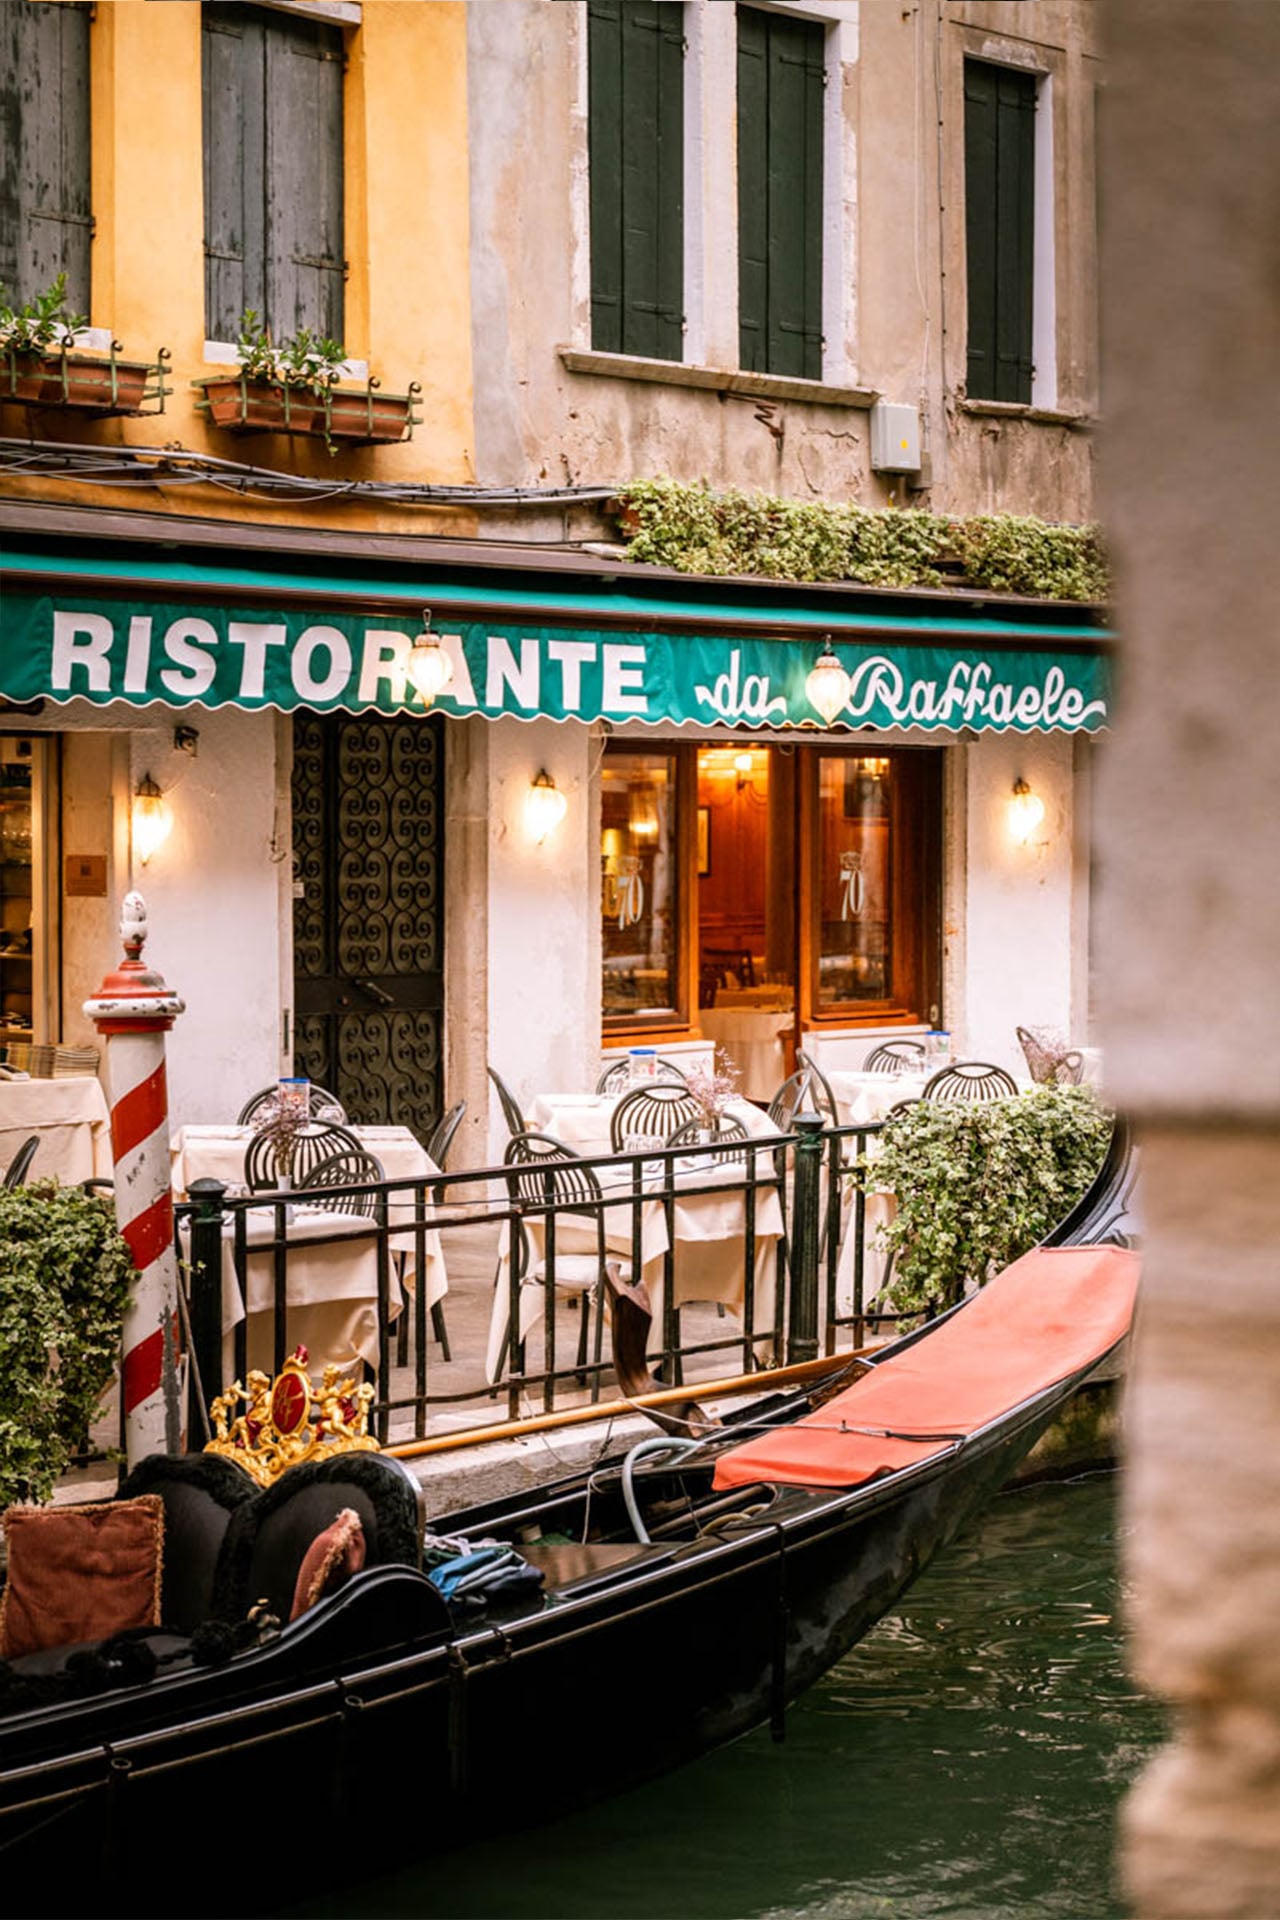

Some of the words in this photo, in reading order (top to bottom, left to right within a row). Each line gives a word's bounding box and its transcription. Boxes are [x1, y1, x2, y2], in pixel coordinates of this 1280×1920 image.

[51, 610, 649, 713] RISTORANTE
[694, 649, 788, 718] da
[846, 655, 1107, 725] Raffaele
